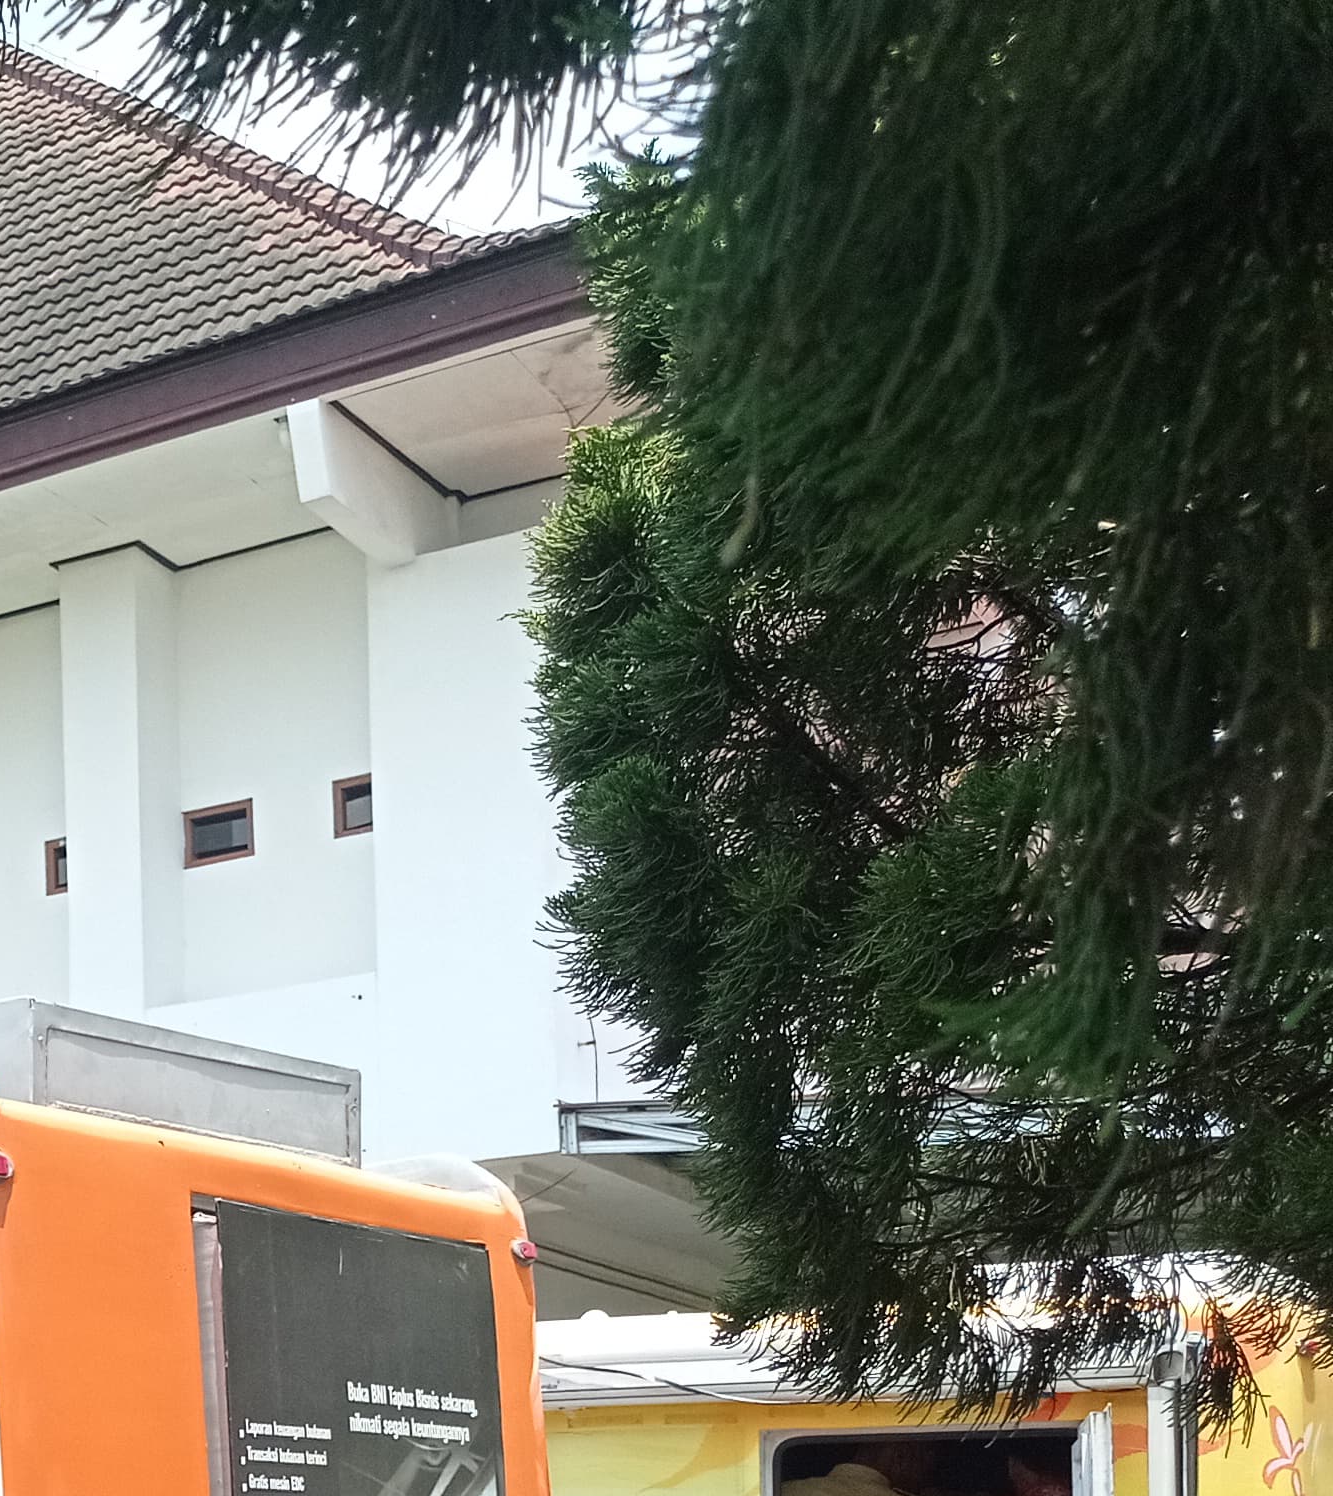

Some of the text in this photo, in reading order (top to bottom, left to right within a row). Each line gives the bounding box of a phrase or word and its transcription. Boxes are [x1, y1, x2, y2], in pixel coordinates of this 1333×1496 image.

[347, 1381, 370, 1402] Buka
[371, 1384, 387, 1405] BNI
[388, 1386, 414, 1410] Taplus
[415, 1389, 440, 1411] Bisnis
[245, 1418, 273, 1438] Laporan
[349, 1412, 382, 1434] nikmati
[383, 1416, 410, 1439] segala
[248, 1473, 269, 1490] Gratis
